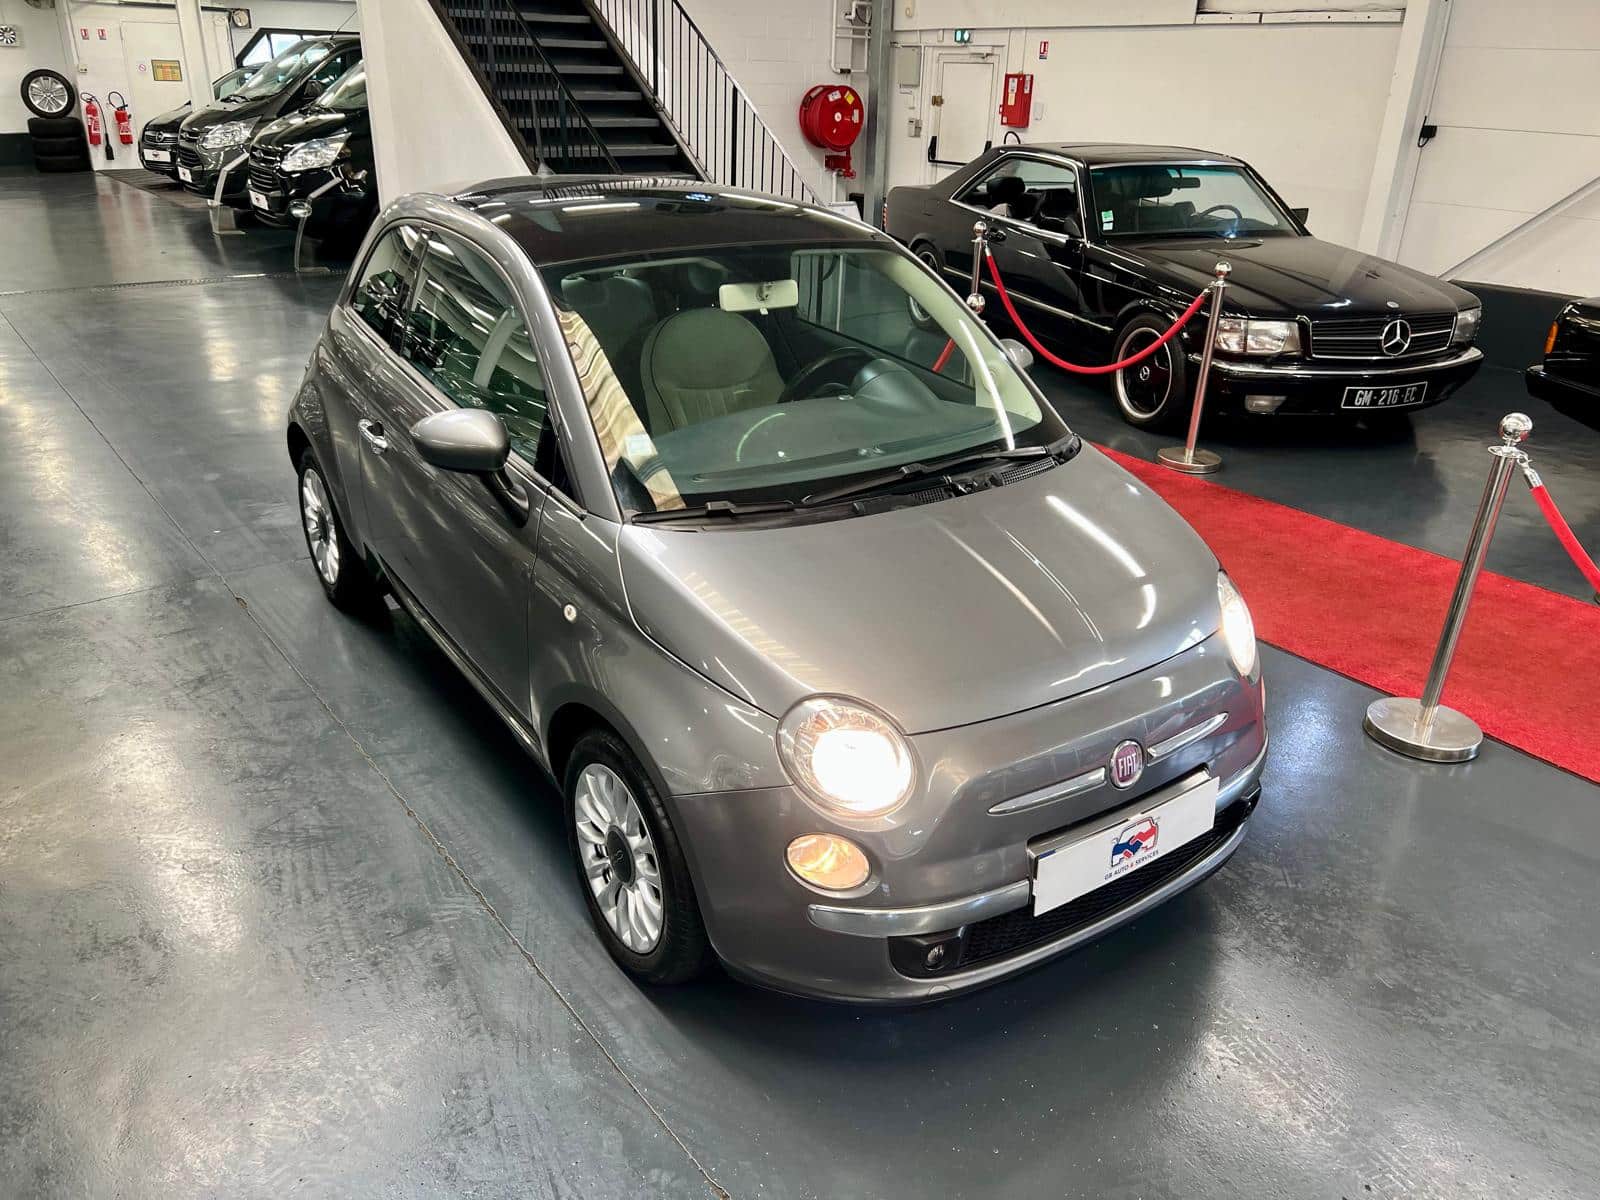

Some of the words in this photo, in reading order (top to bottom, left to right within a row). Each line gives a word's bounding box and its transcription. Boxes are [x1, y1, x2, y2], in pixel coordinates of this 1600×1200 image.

[1118, 752, 1137, 778] FIAT
[1114, 864, 1130, 875] AUTO
[1135, 850, 1159, 864] SERVICES
